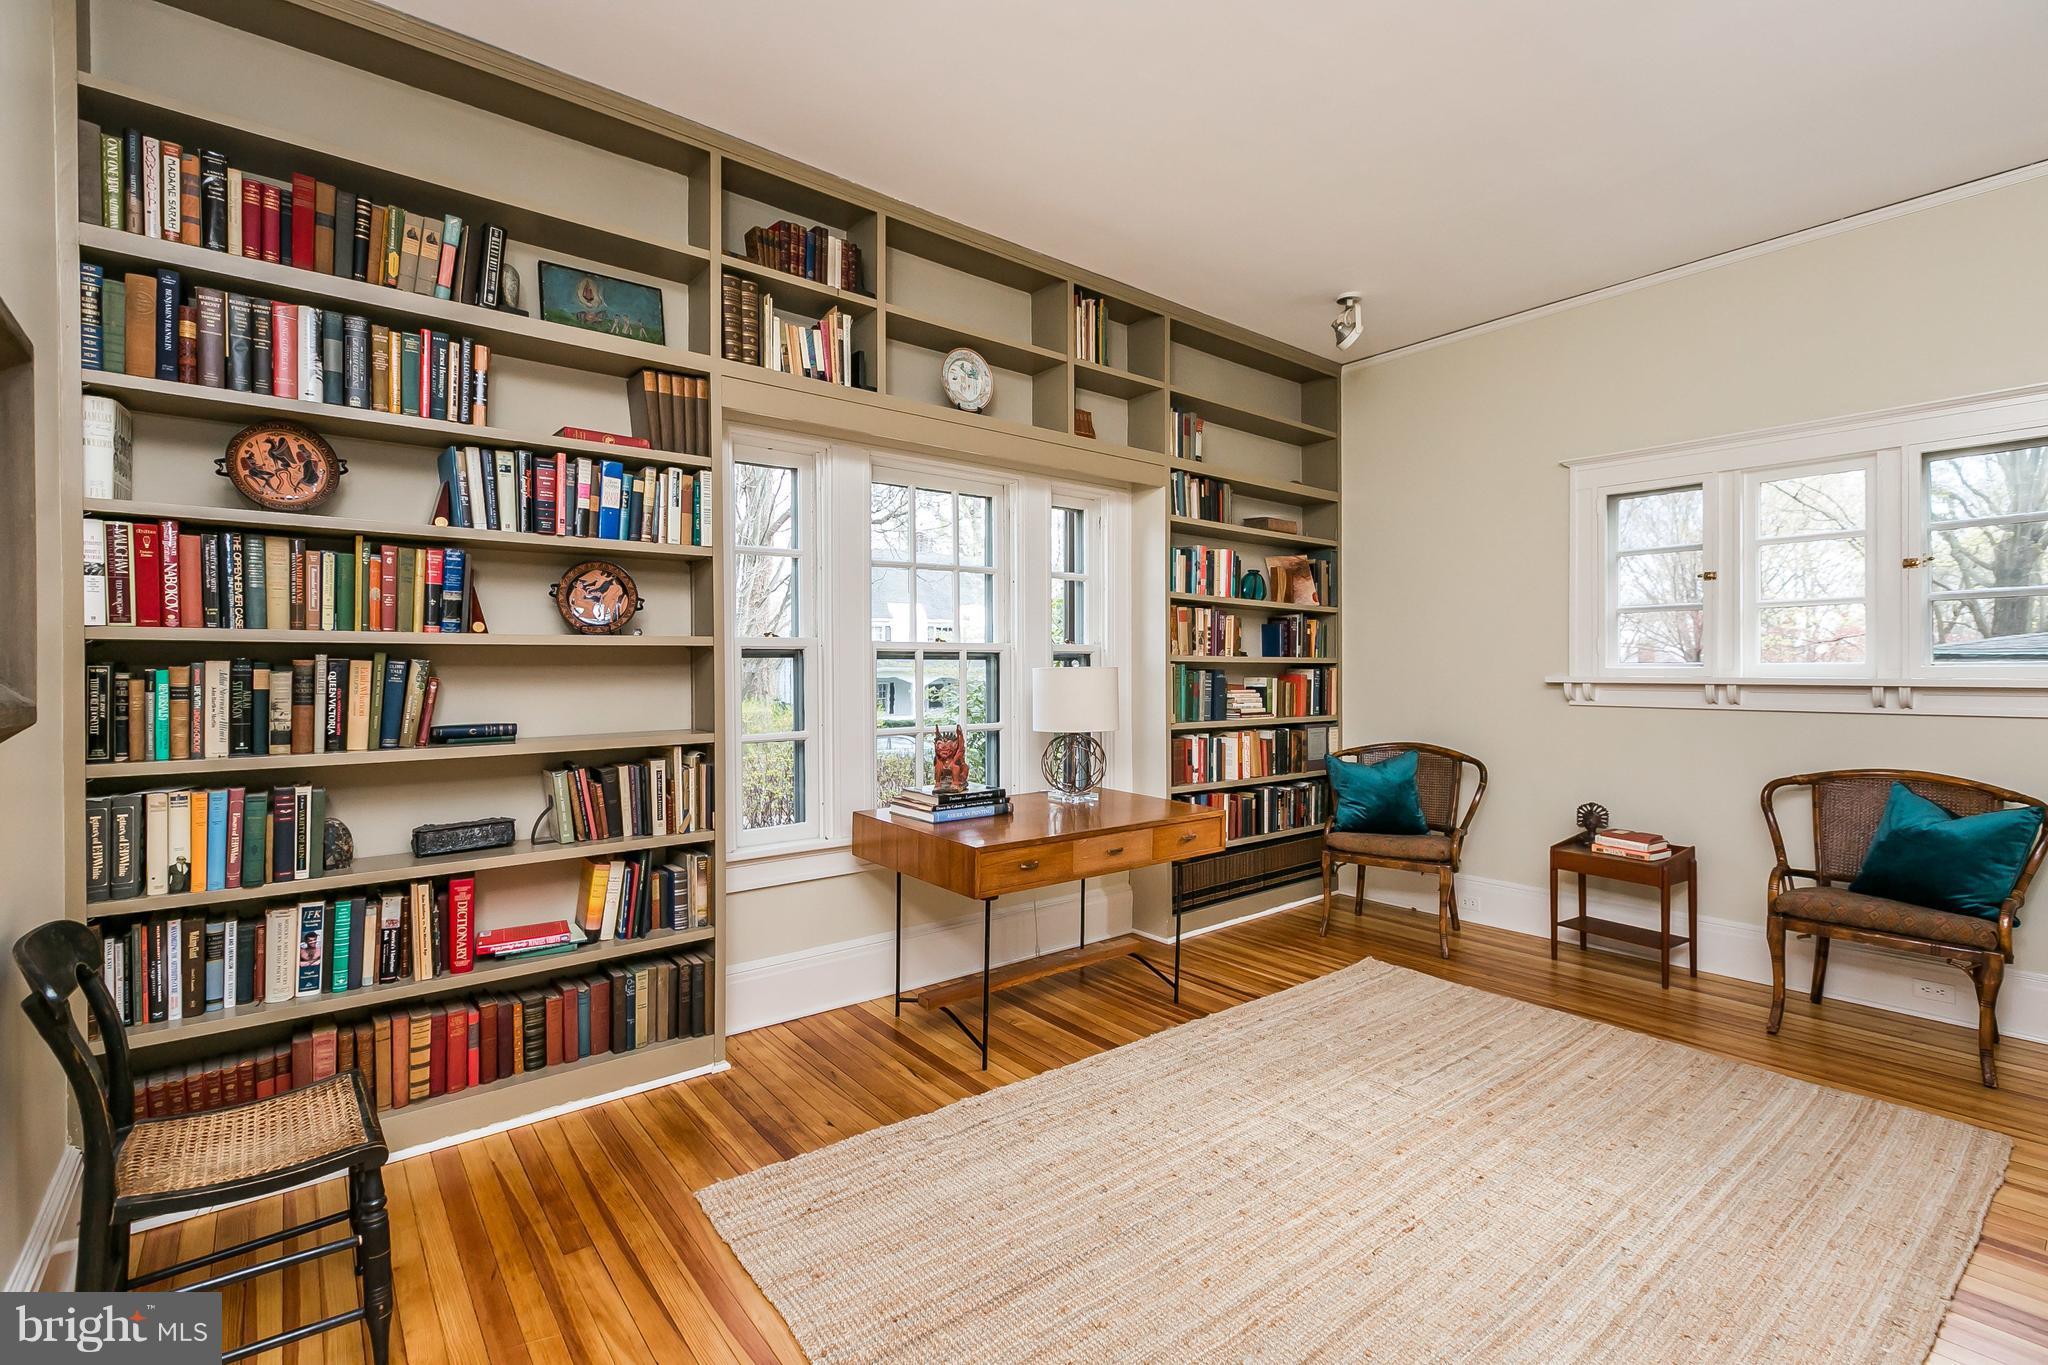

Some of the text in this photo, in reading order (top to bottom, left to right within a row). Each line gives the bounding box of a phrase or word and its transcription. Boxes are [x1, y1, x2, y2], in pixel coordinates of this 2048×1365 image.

[168, 159, 176, 196] MADAME
[168, 200, 176, 229] SARAH
[164, 289, 172, 319] BENJAMIN
[198, 294, 222, 303] ROBERT
[229, 299, 252, 308] ROBERT
[164, 320, 173, 351] FRANKLIN
[438, 367, 446, 398] Hemingway
[462, 360, 470, 395] LEOPOLD'S
[114, 528, 128, 574] MAUGHAM
[164, 563, 178, 612] NABOKOV
[233, 552, 243, 607] OPPENHEIMER
[112, 591, 123, 615] MORGAN
[235, 608, 244, 629] CASE
[232, 681, 243, 719] STEVENSON
[242, 690, 251, 709] ADLAI
[327, 671, 337, 735] QUEEN VICTORIA
[359, 667, 369, 718] Edith Wharton
[89, 816, 102, 837] Letters
[117, 814, 128, 835] Letters
[298, 835, 305, 843] OF
[303, 910, 321, 919] JFK
[456, 901, 468, 961] DICTIONARY
